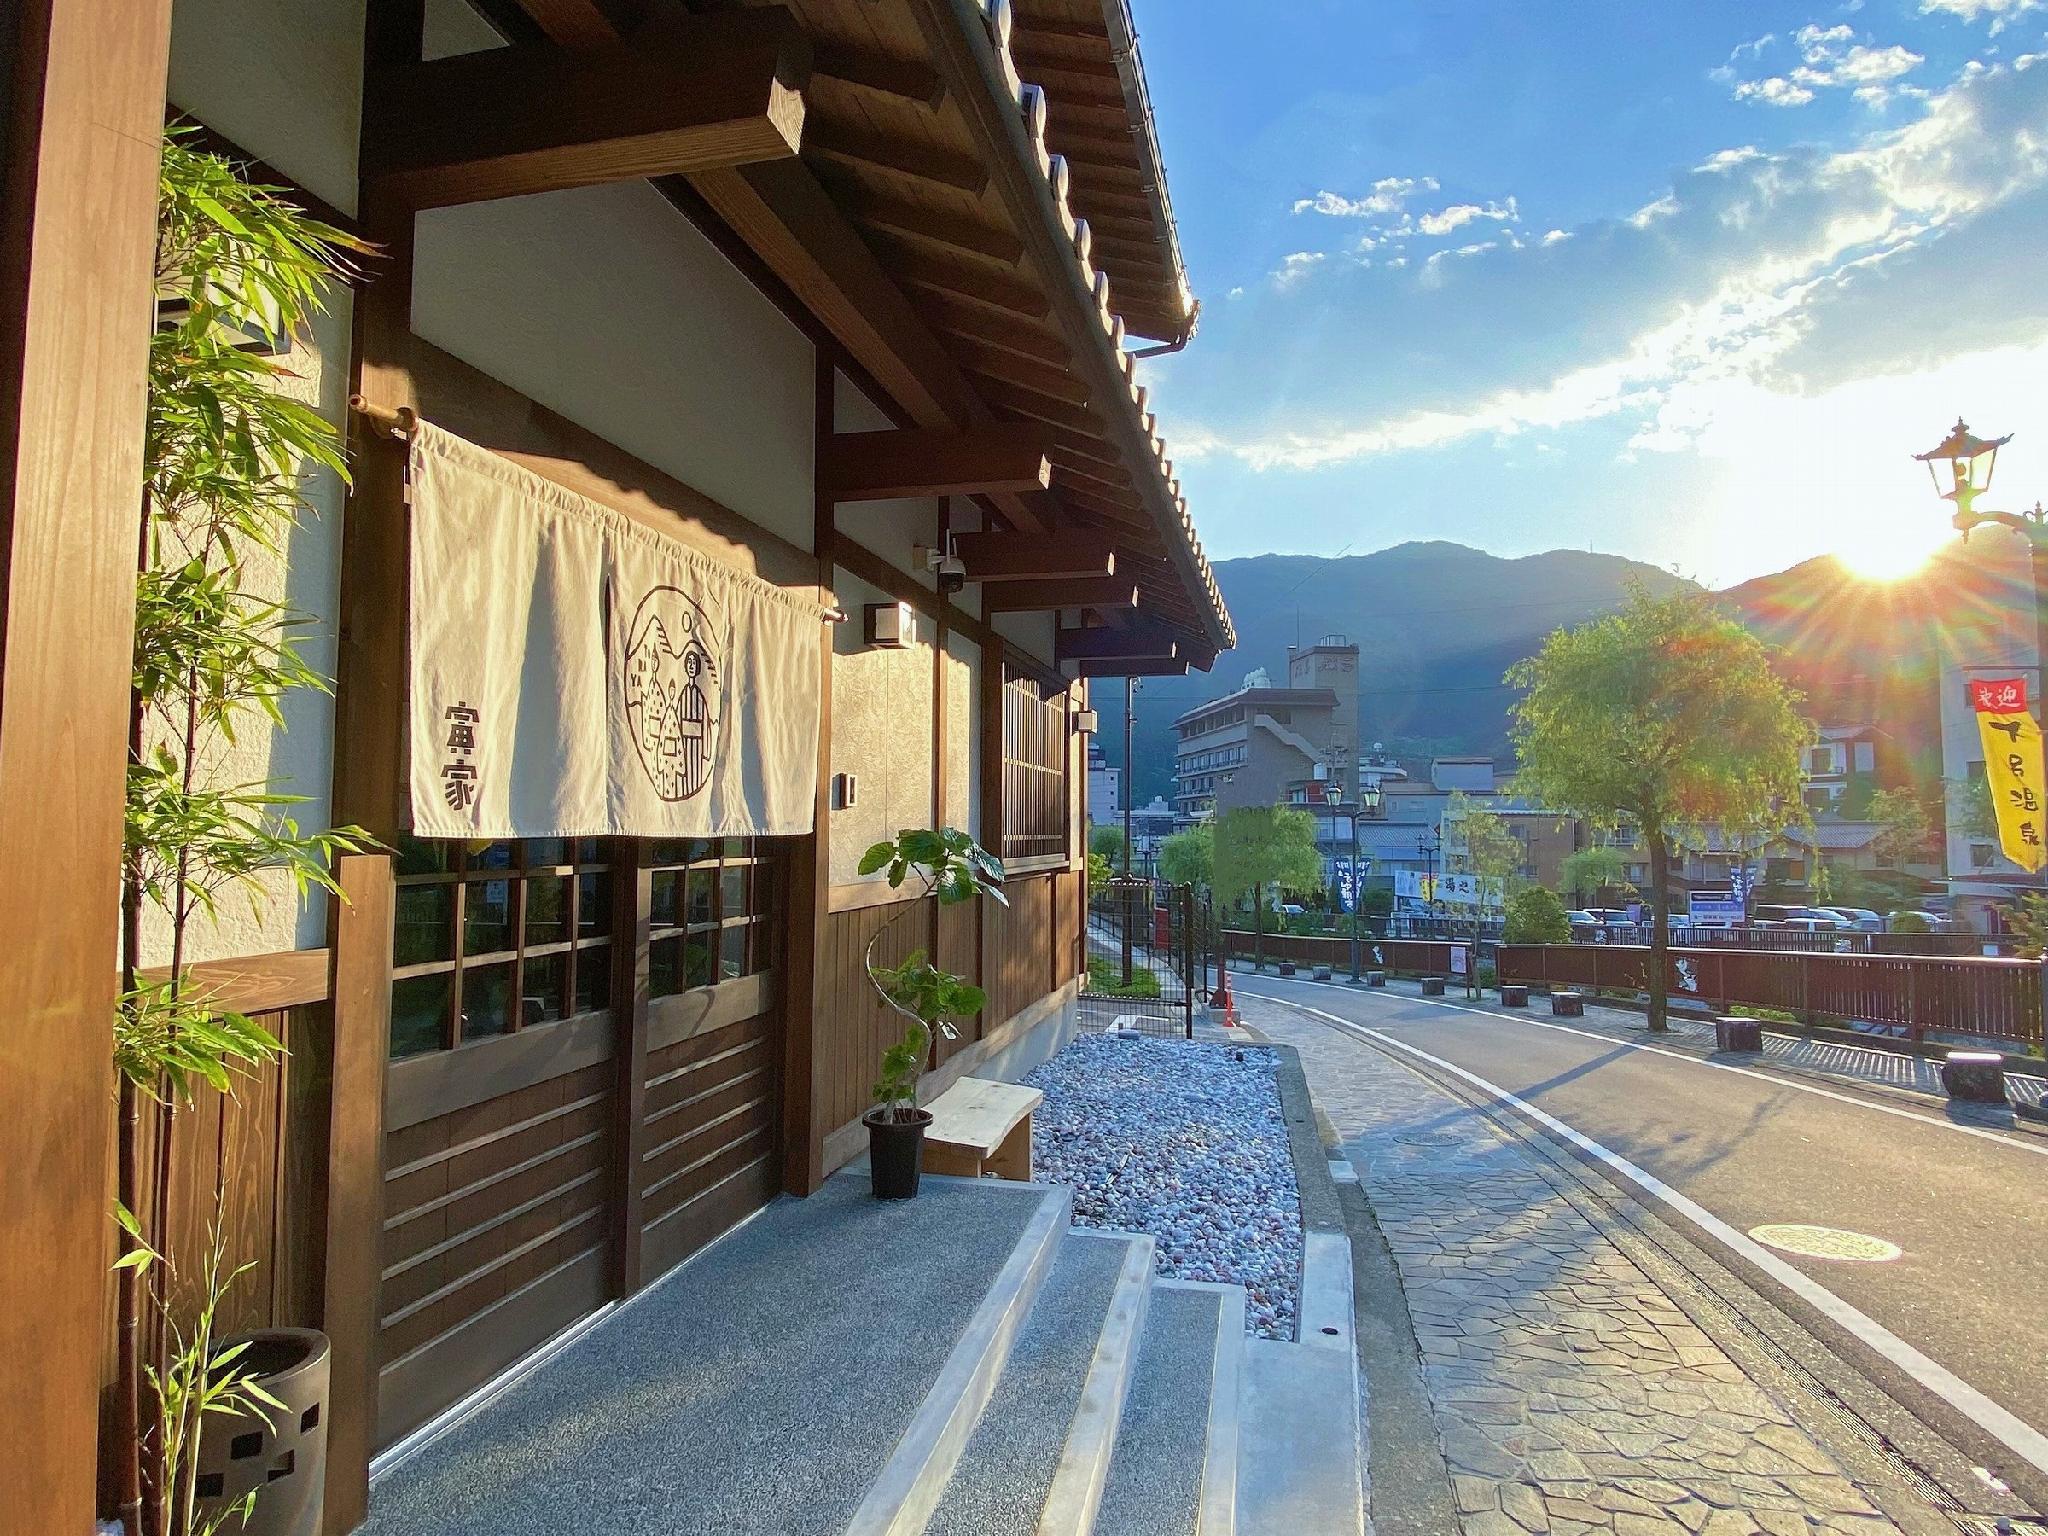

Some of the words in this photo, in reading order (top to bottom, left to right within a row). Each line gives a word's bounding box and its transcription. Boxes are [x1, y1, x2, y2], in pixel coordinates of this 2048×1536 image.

[1978, 685, 2021, 710] 歓迎
[440, 701, 480, 811] 富家
[1988, 720, 2040, 847] 下呂温泉
